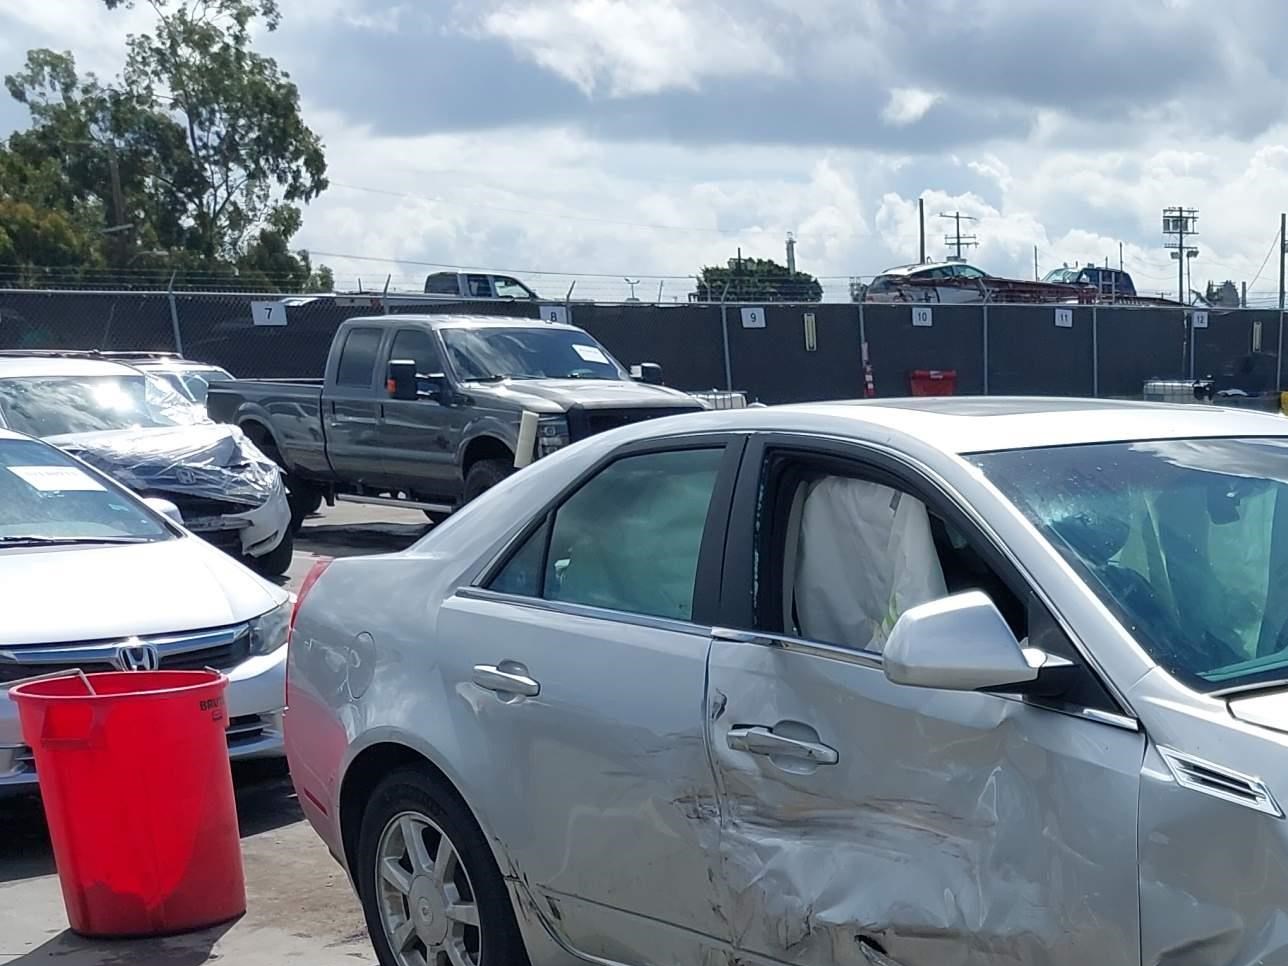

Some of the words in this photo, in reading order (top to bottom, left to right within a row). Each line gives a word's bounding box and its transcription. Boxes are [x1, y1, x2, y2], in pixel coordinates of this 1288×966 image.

[264, 307, 273, 320] 7
[750, 312, 757, 323] 9
[918, 311, 928, 322] 10
